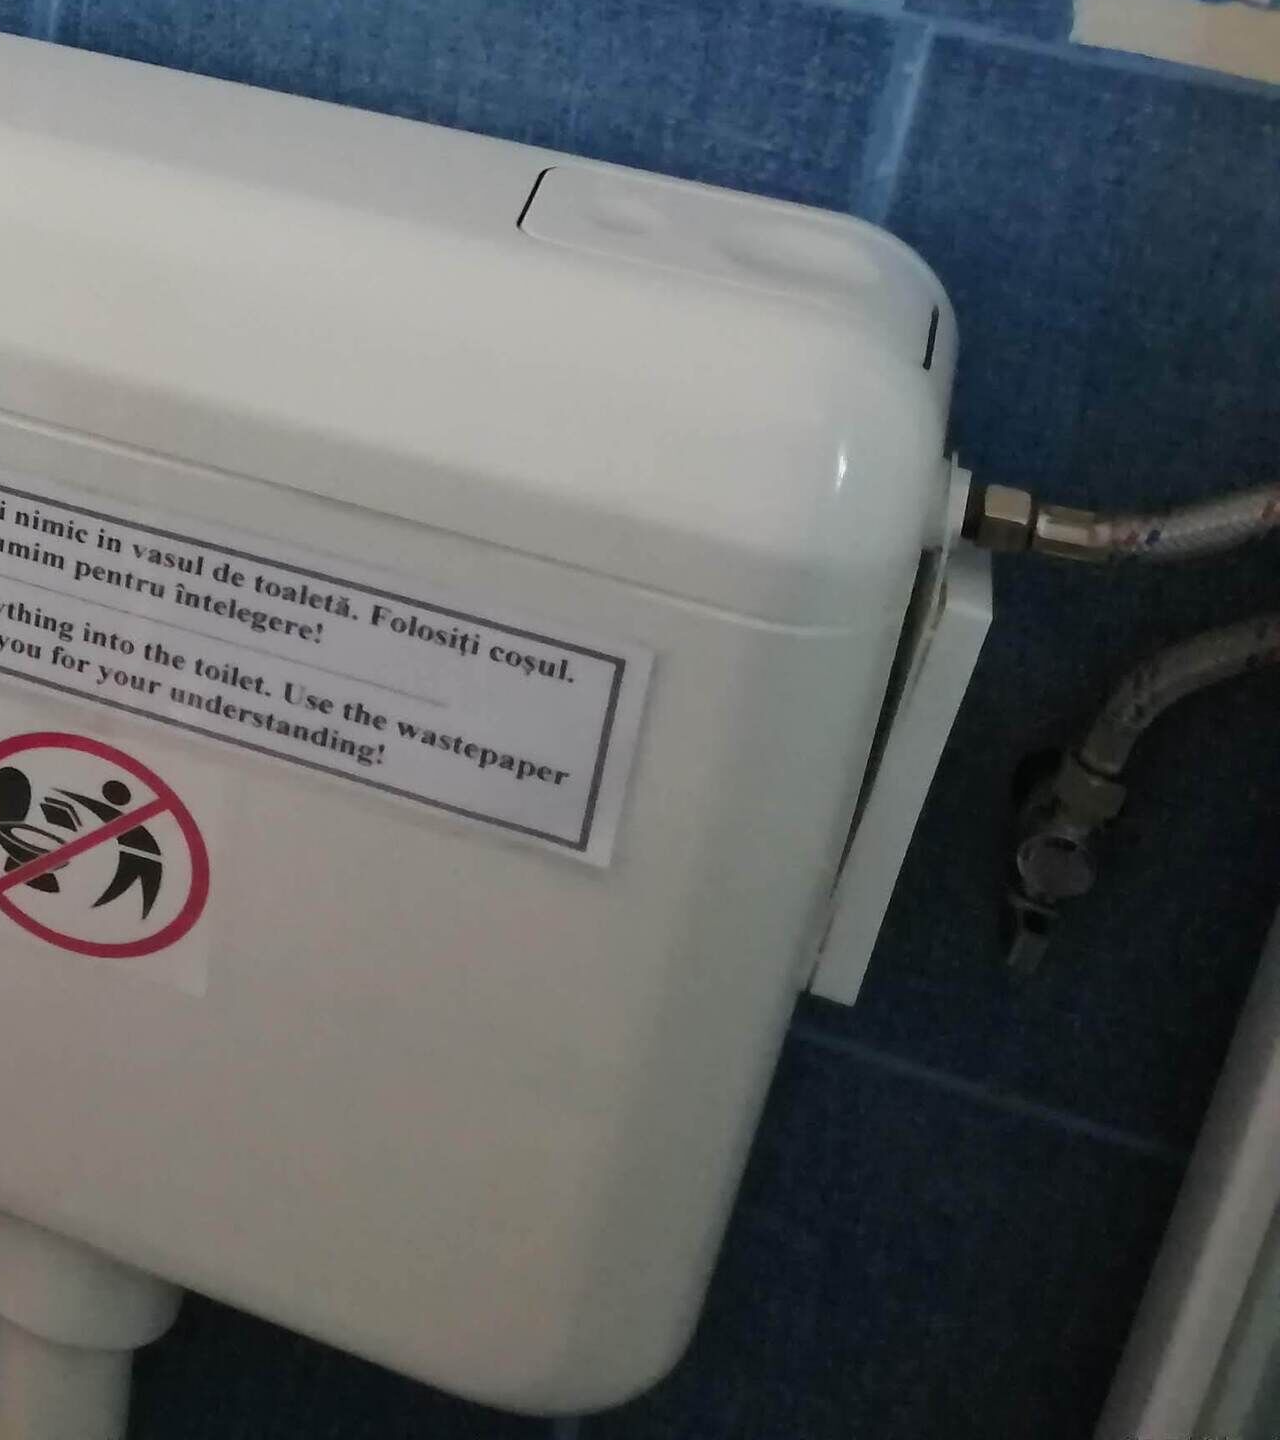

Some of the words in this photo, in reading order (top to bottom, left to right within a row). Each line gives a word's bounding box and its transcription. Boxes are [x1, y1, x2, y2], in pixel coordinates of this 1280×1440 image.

[14, 508, 89, 544] nimic
[96, 527, 122, 553] in
[132, 543, 204, 576] vasul
[212, 562, 245, 587] de
[254, 574, 358, 620] toaletă.
[73, 560, 165, 599] pentru
[51, 646, 92, 674] for
[95, 663, 163, 696] your
[169, 684, 387, 767] understanding!
[82, 621, 136, 656] into
[143, 642, 186, 671] the
[194, 658, 272, 698] toilet.
[283, 681, 335, 715] Use
[342, 702, 388, 732] the
[396, 720, 570, 786] wastepaper
